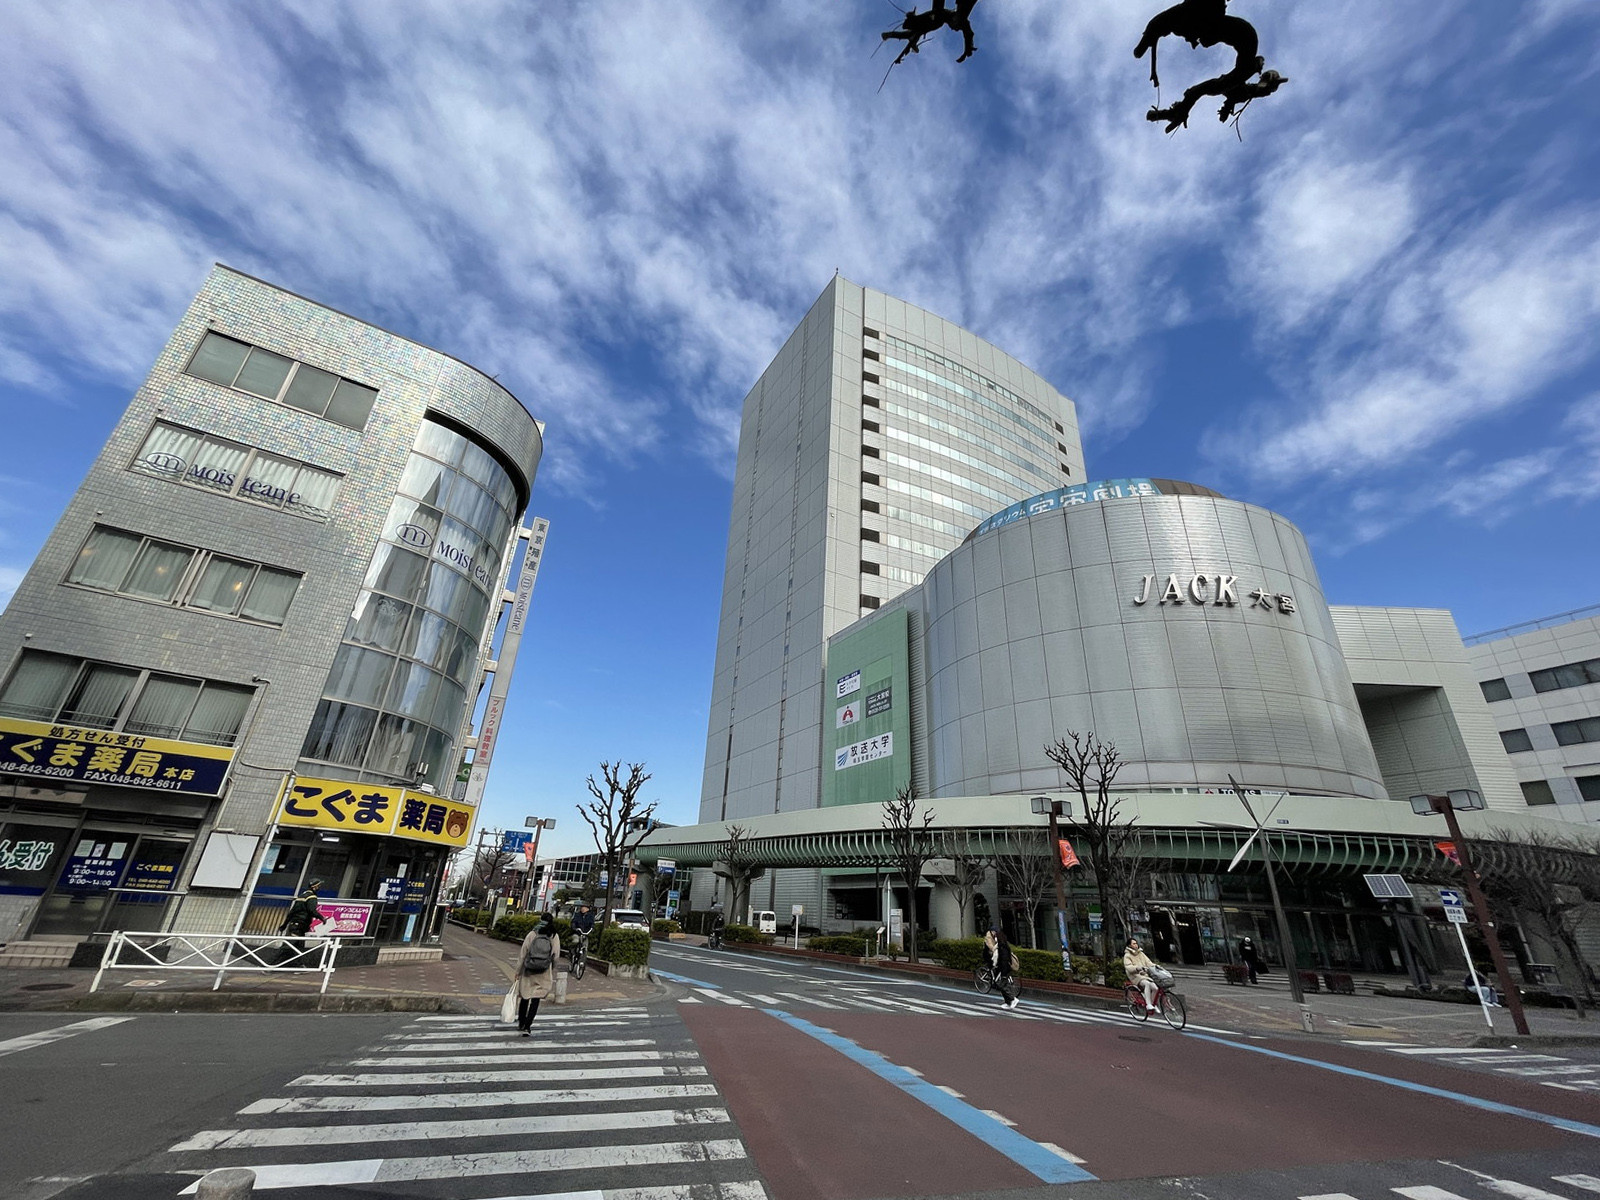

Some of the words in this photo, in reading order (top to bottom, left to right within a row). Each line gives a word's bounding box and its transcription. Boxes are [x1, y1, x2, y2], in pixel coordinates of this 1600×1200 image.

[1133, 573, 1240, 605] JACK
[1249, 587, 1296, 615] 大宮
[49, 726, 146, 748] 処方せん受付
[851, 735, 889, 757] 放送大学
[0, 735, 162, 778] ぐま薬局
[163, 767, 195, 781] 本店
[0, 759, 75, 778] 48-642-6200
